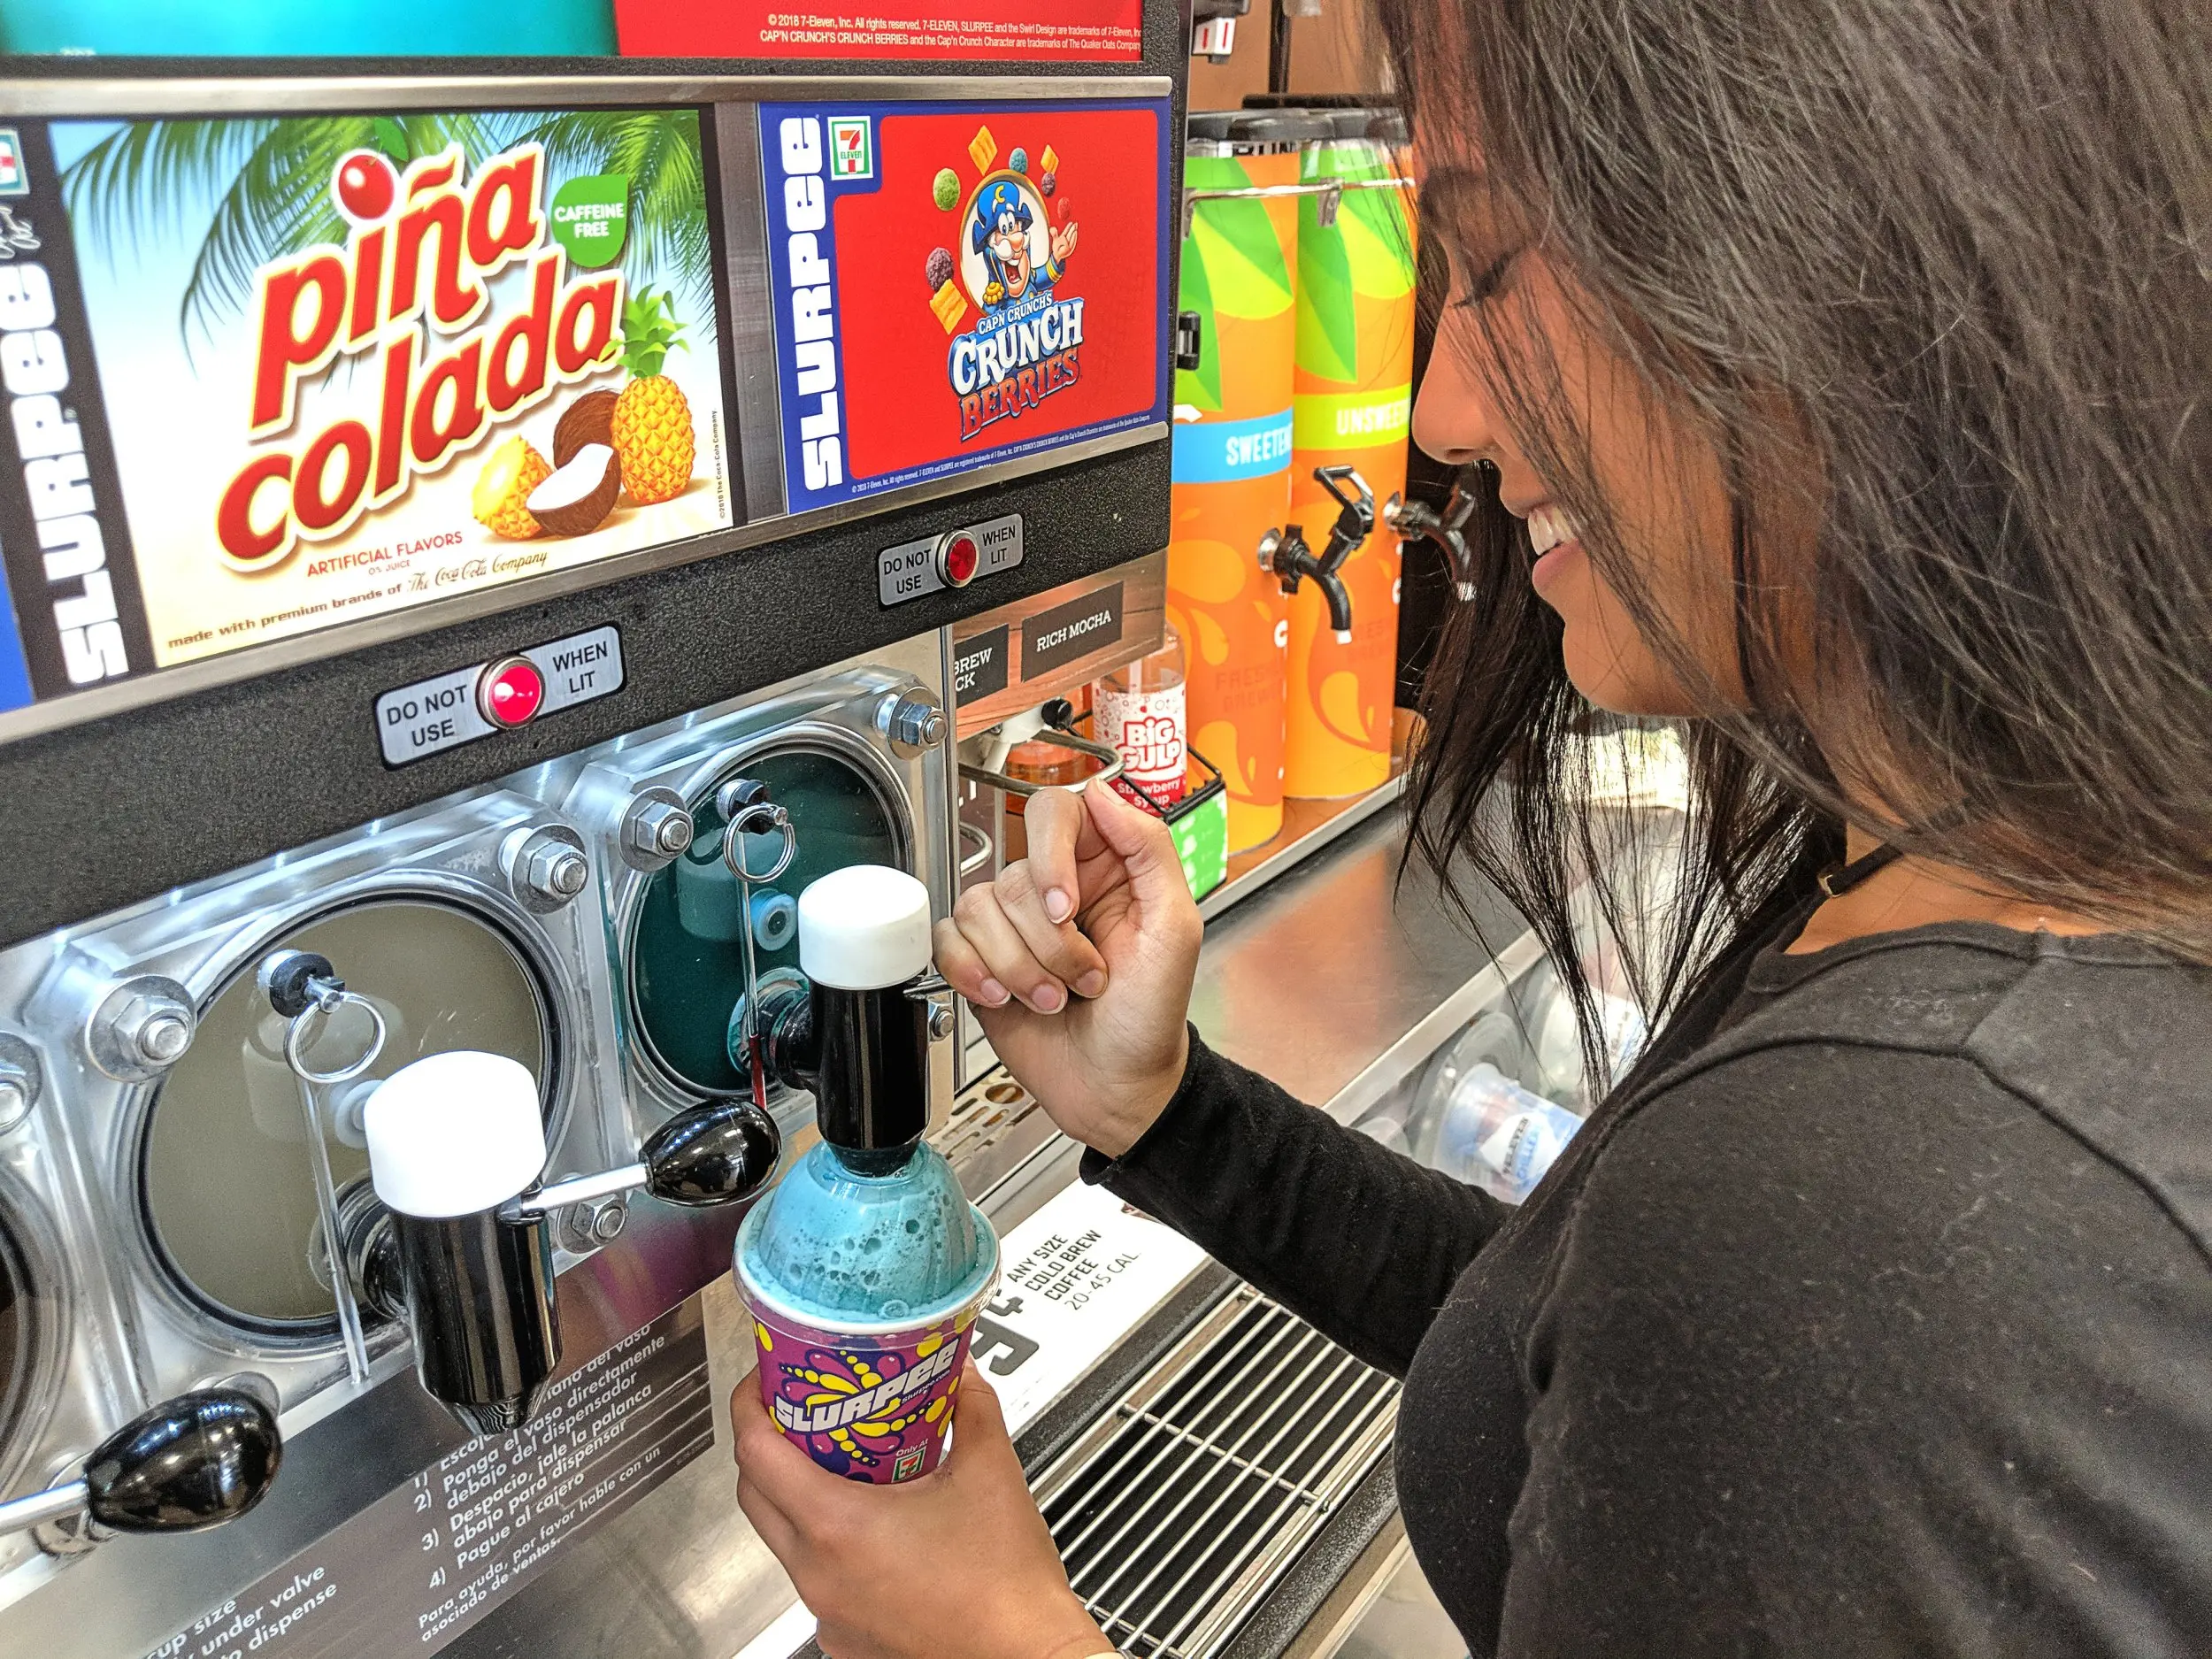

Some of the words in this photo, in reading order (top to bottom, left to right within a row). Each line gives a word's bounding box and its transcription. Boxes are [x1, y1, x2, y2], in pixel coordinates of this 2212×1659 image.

[760, 30, 788, 42] CAP'N
[790, 31, 835, 42] CRUNCH'S
[837, 32, 872, 44] CRUNCH
[875, 33, 908, 44] BERRIES
[910, 35, 924, 45] and
[925, 35, 935, 45] the
[938, 35, 958, 48] Cap'n
[959, 36, 982, 46] Crunch
[984, 36, 1014, 47] Character
[1027, 39, 1060, 48] trademarks
[1062, 39, 1069, 48] of
[1070, 39, 1079, 49] The
[1081, 41, 1101, 50] Quaker
[1102, 41, 1115, 50] Oats
[779, 15, 798, 27] 2018
[802, 15, 837, 28] 7-Eleven,
[840, 17, 853, 28] Inc.
[855, 17, 864, 28] All
[866, 17, 887, 31] rights
[888, 19, 920, 30] reserved.
[923, 19, 960, 33] 7-ELEVEN,
[961, 21, 993, 33] SLURPEE
[995, 22, 1007, 33] and
[1008, 23, 1018, 33] the
[1019, 23, 1034, 34] Swirl
[1036, 24, 1056, 36] Design
[1058, 27, 1067, 35] are
[1068, 26, 1099, 35] trademarks
[1101, 27, 1107, 35] of
[1108, 27, 1133, 38] 7-Eleven,
[554, 203, 625, 222] CAFFEINE
[574, 221, 609, 239] FREE
[250, 149, 538, 431] piña
[951, 299, 1084, 396] CRUNCH
[217, 253, 619, 561] colada
[961, 349, 1080, 441] BERRIES
[306, 547, 393, 578] ARTIFICIAL
[396, 531, 464, 557] FLAVORS
[982, 525, 1016, 546] WHEN
[385, 558, 411, 572] JUICE
[884, 557, 902, 575] DO
[906, 549, 931, 567] NOT
[991, 549, 1007, 565] LIT
[167, 629, 214, 649] made
[219, 618, 257, 636] with
[261, 602, 328, 628] premium
[333, 588, 382, 609] brands
[388, 582, 402, 595] of
[491, 549, 549, 574] Company
[896, 575, 921, 594] USE
[1037, 627, 1067, 652] RICH
[1069, 610, 1111, 637] MOCHA
[552, 641, 608, 672] WHEN
[569, 671, 595, 694] LIT
[387, 701, 418, 726] DO
[425, 685, 467, 714] NOT
[411, 718, 455, 747] USE
[1116, 736, 1182, 772] GULP
[1117, 778, 1180, 795] Stwberry
[1134, 795, 1170, 808] Syup
[1007, 1258, 1037, 1283] ANY
[1033, 1234, 1068, 1260] SIZE
[1025, 1261, 1065, 1291] COLD
[1059, 1229, 1102, 1263] BREW
[1044, 1258, 1099, 1301] COFFEE
[1064, 1273, 1111, 1310] 20-45
[414, 1488, 432, 1513] 2)
[443, 1448, 499, 1493] Ponga
[503, 1429, 519, 1451] el
[523, 1407, 563, 1437] vaso
[567, 1336, 664, 1409] directamente
[447, 1464, 507, 1510] debajo
[512, 1438, 537, 1465] del
[542, 1371, 637, 1445] dispensador
[421, 1528, 439, 1551] 3)
[449, 1468, 534, 1532] Despacio,
[538, 1443, 567, 1475] jale
[572, 1430, 587, 1447] la
[592, 1384, 652, 1436] palanca
[895, 1445, 918, 1456] Only
[919, 1439, 928, 1448] At
[453, 1507, 503, 1548] abajo
[508, 1479, 548, 1515] para
[552, 1417, 627, 1479] dispensar
[418, 1597, 454, 1629] Para
[458, 1561, 509, 1600] ayuda,
[513, 1540, 536, 1563] por
[540, 1509, 575, 1540] favor
[580, 1479, 616, 1511] hable
[618, 1461, 641, 1482] con
[645, 1446, 661, 1463] un
[428, 1566, 446, 1589] 4)
[457, 1525, 511, 1570] Pague
[515, 1505, 531, 1528] al
[535, 1472, 585, 1516] cajero
[421, 1590, 488, 1642] asociado
[491, 1570, 509, 1591] de
[511, 1537, 562, 1576] ventas.
[194, 1599, 237, 1636] size
[201, 1606, 265, 1656] under
[270, 1566, 326, 1609] valve
[248, 1584, 337, 1650] dispense
